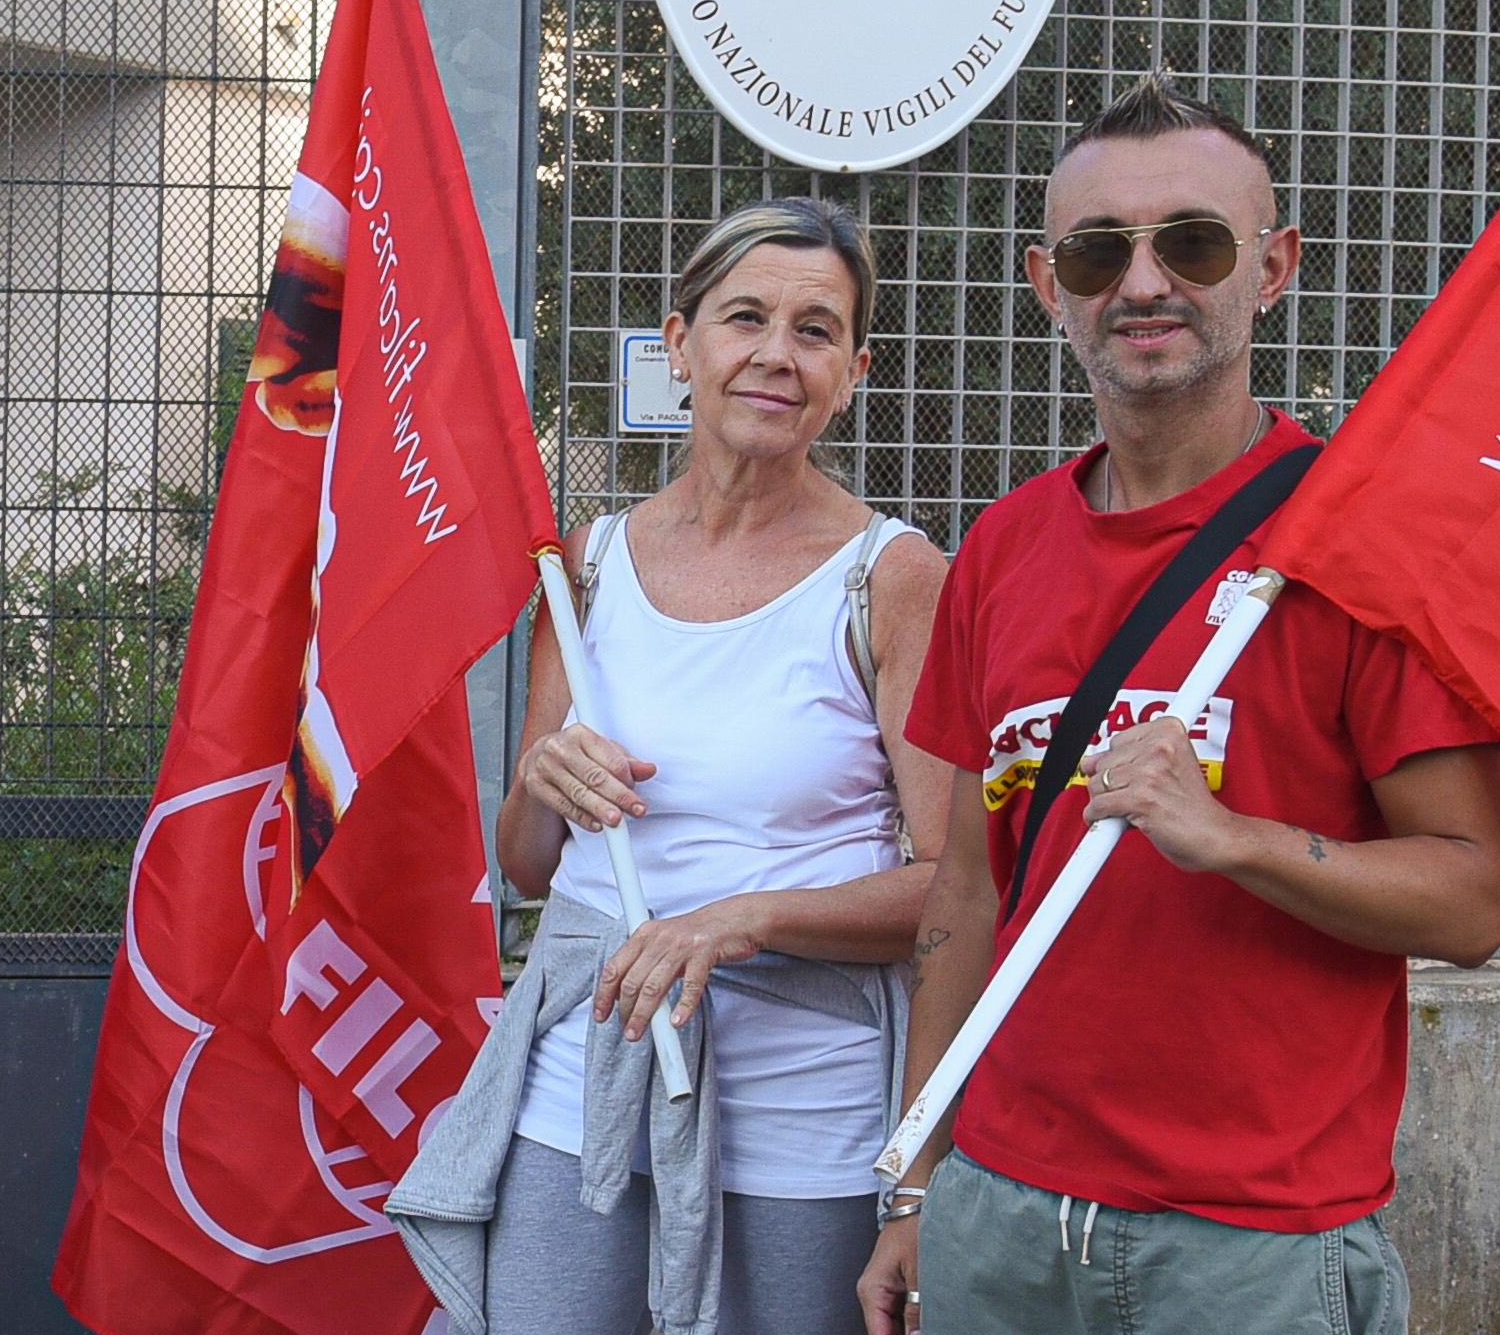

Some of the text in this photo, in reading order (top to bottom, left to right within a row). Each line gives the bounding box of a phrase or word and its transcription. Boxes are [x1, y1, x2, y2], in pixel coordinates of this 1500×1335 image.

[704, 15, 854, 138] NAZIONALE
[862, 78, 957, 137] VIGILI
[954, 33, 1002, 92] DEL
